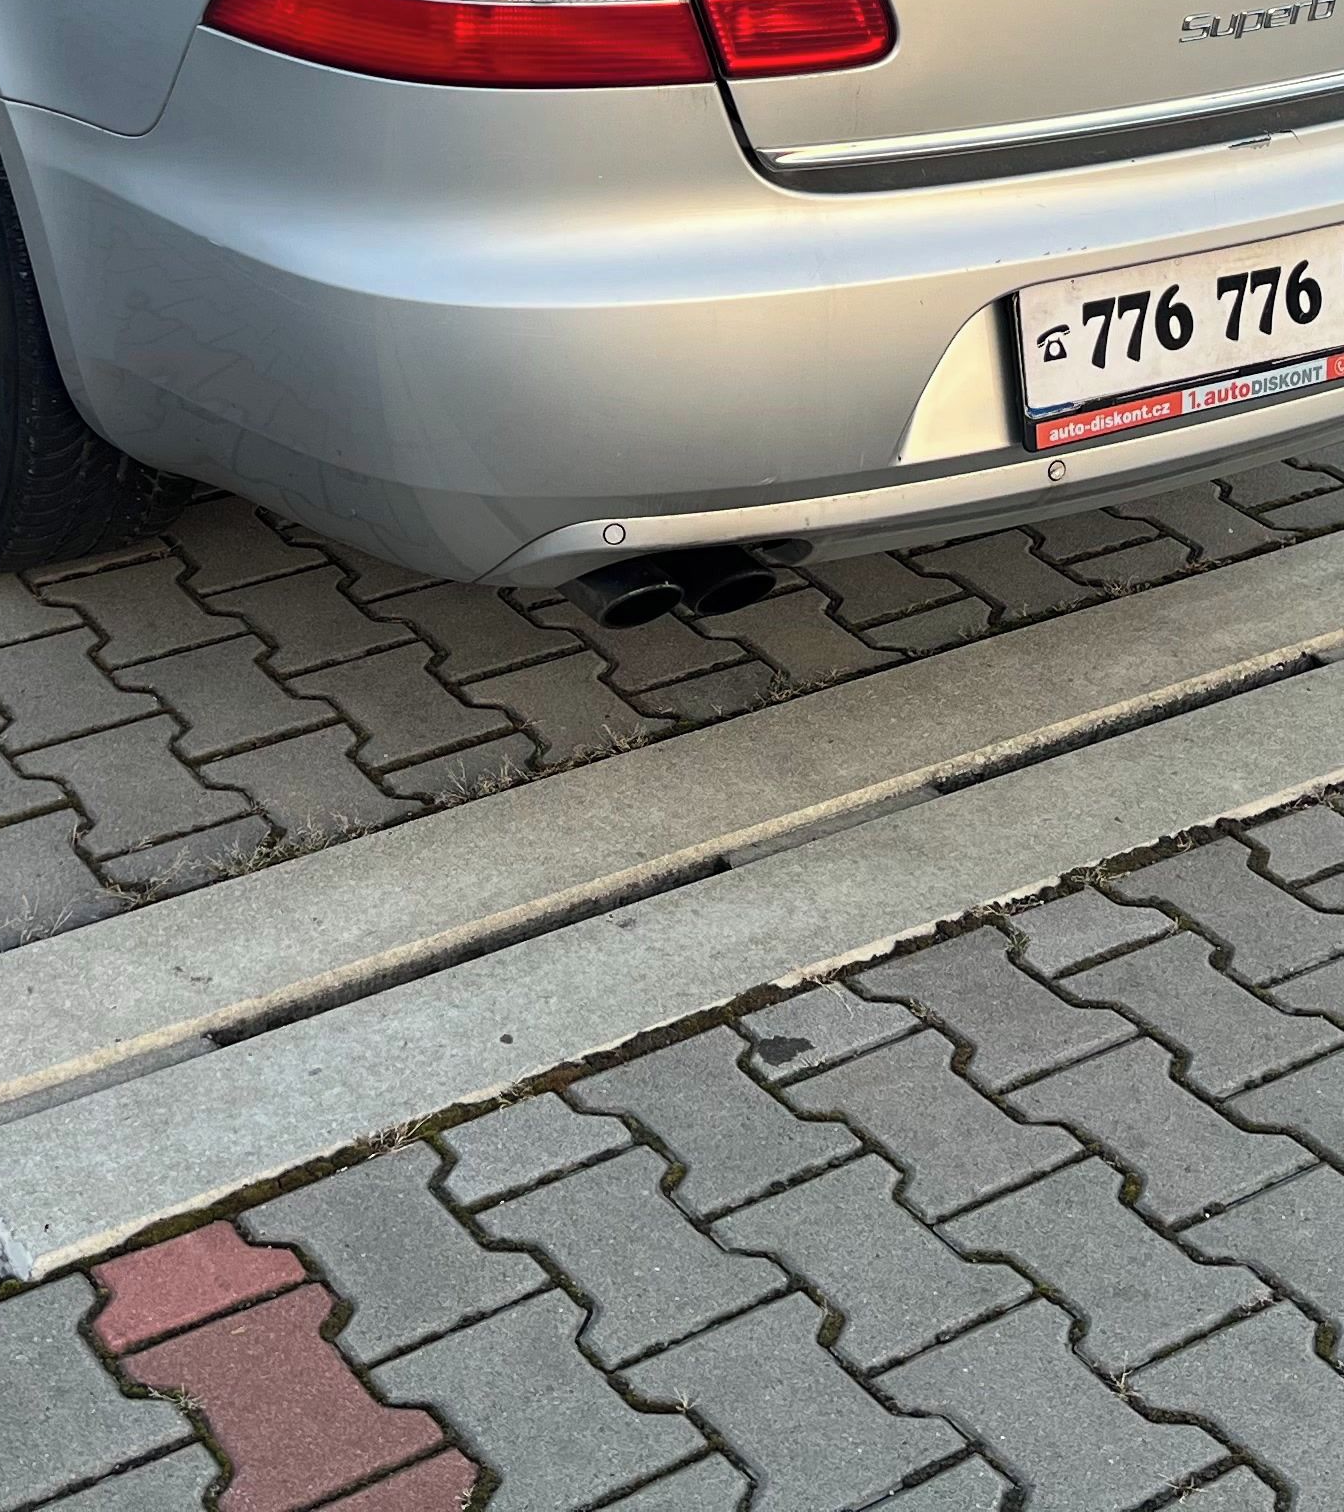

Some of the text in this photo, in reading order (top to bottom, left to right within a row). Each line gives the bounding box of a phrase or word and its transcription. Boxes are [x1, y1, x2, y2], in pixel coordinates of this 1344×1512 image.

[1082, 284, 1194, 369] 776
[1216, 260, 1322, 342] 776
[1049, 402, 1170, 442] auto-diskont.cz
